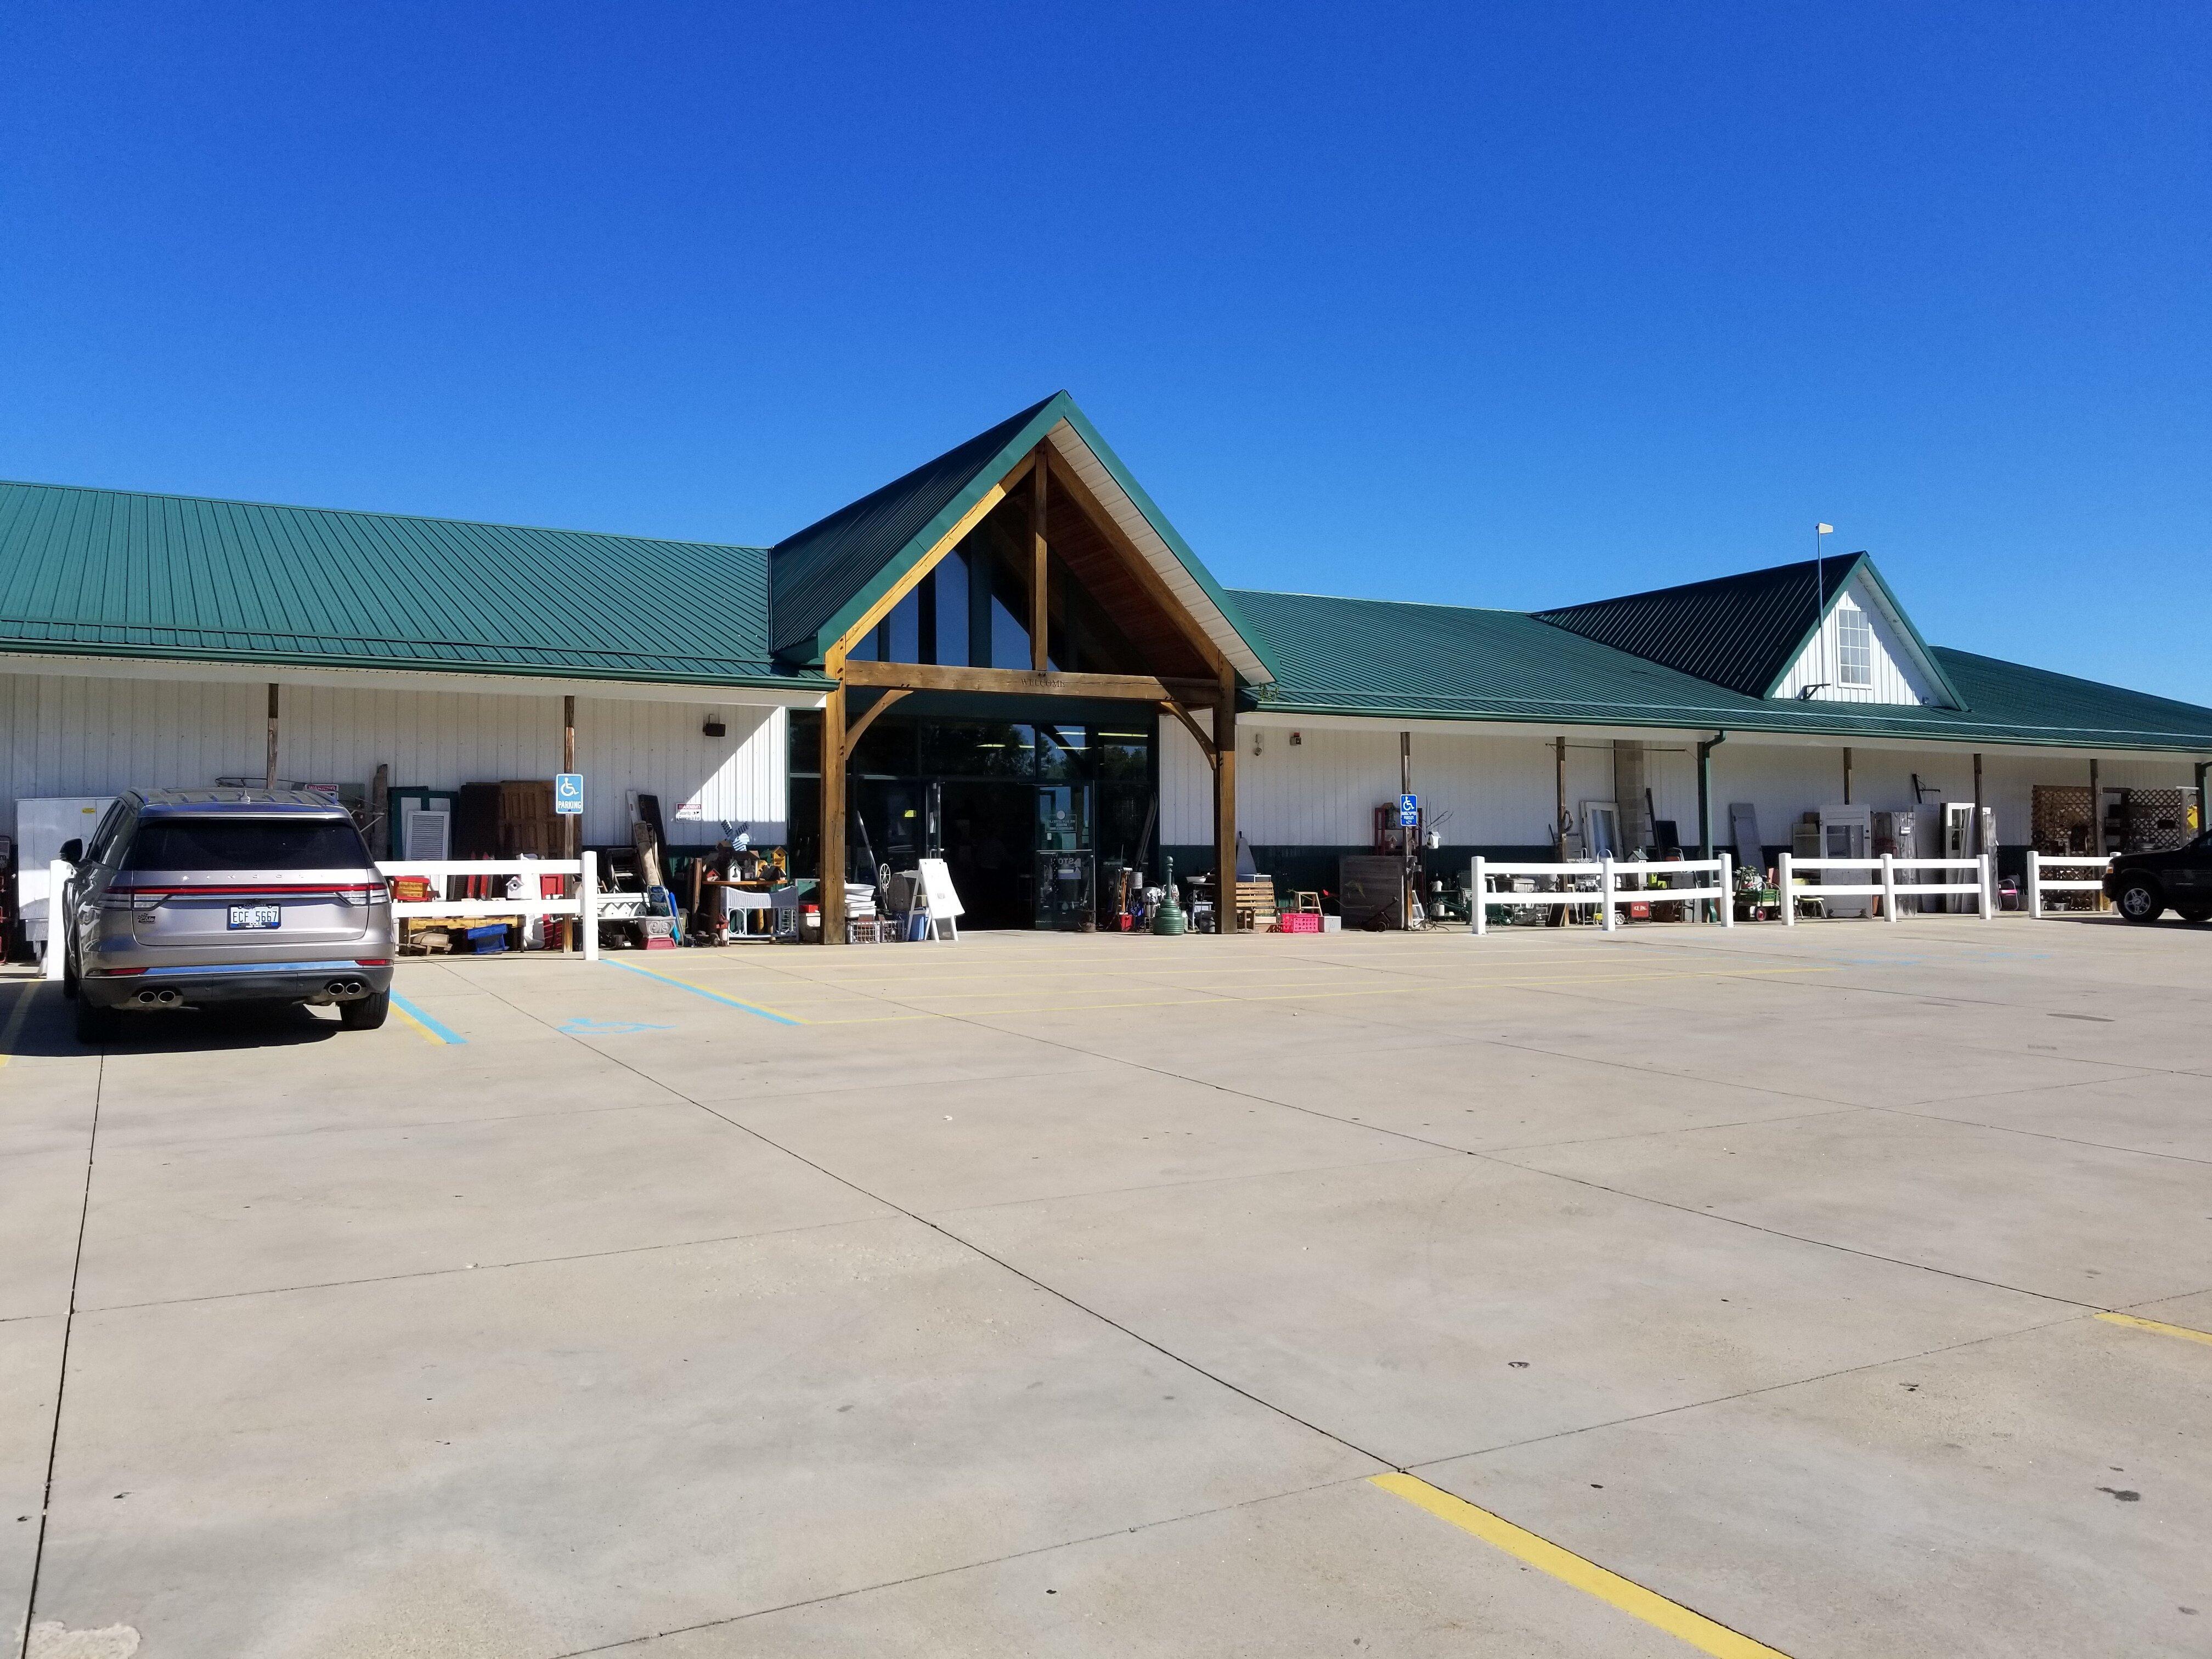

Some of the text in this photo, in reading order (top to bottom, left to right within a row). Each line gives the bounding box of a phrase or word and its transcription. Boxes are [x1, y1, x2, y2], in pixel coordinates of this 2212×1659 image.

[1021, 678, 1065, 687] WELCOME
[558, 800, 582, 809] PARKING
[233, 911, 277, 922] ECF 5667
